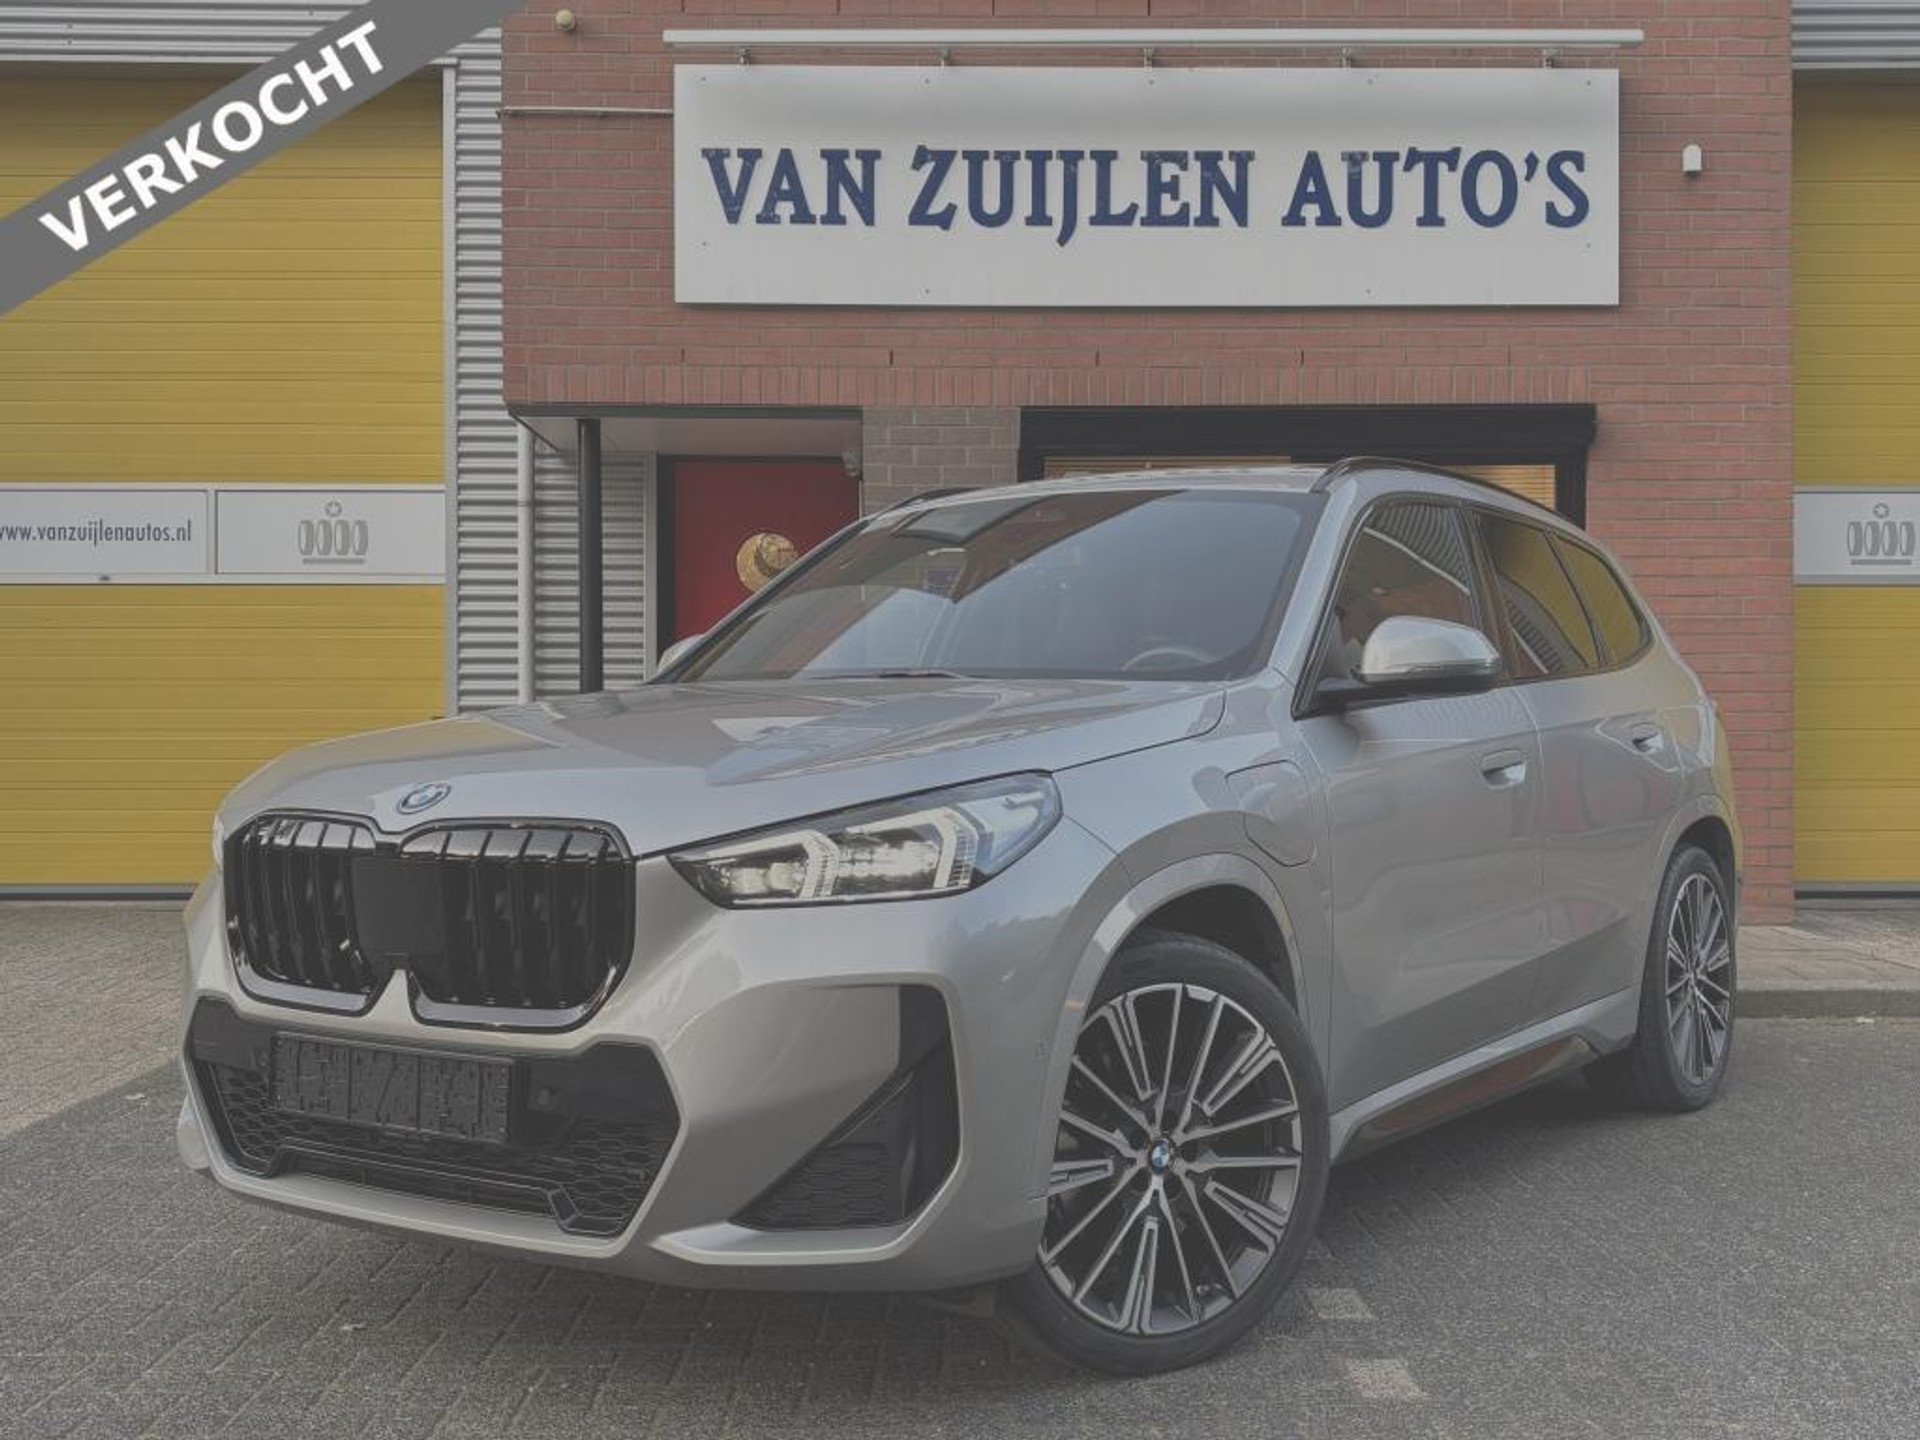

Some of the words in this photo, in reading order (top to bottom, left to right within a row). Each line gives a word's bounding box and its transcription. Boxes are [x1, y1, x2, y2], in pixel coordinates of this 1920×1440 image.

[701, 147, 882, 226] VAN
[908, 144, 1256, 247] ZUIJLEN
[1281, 146, 1590, 229] AUTO'S
